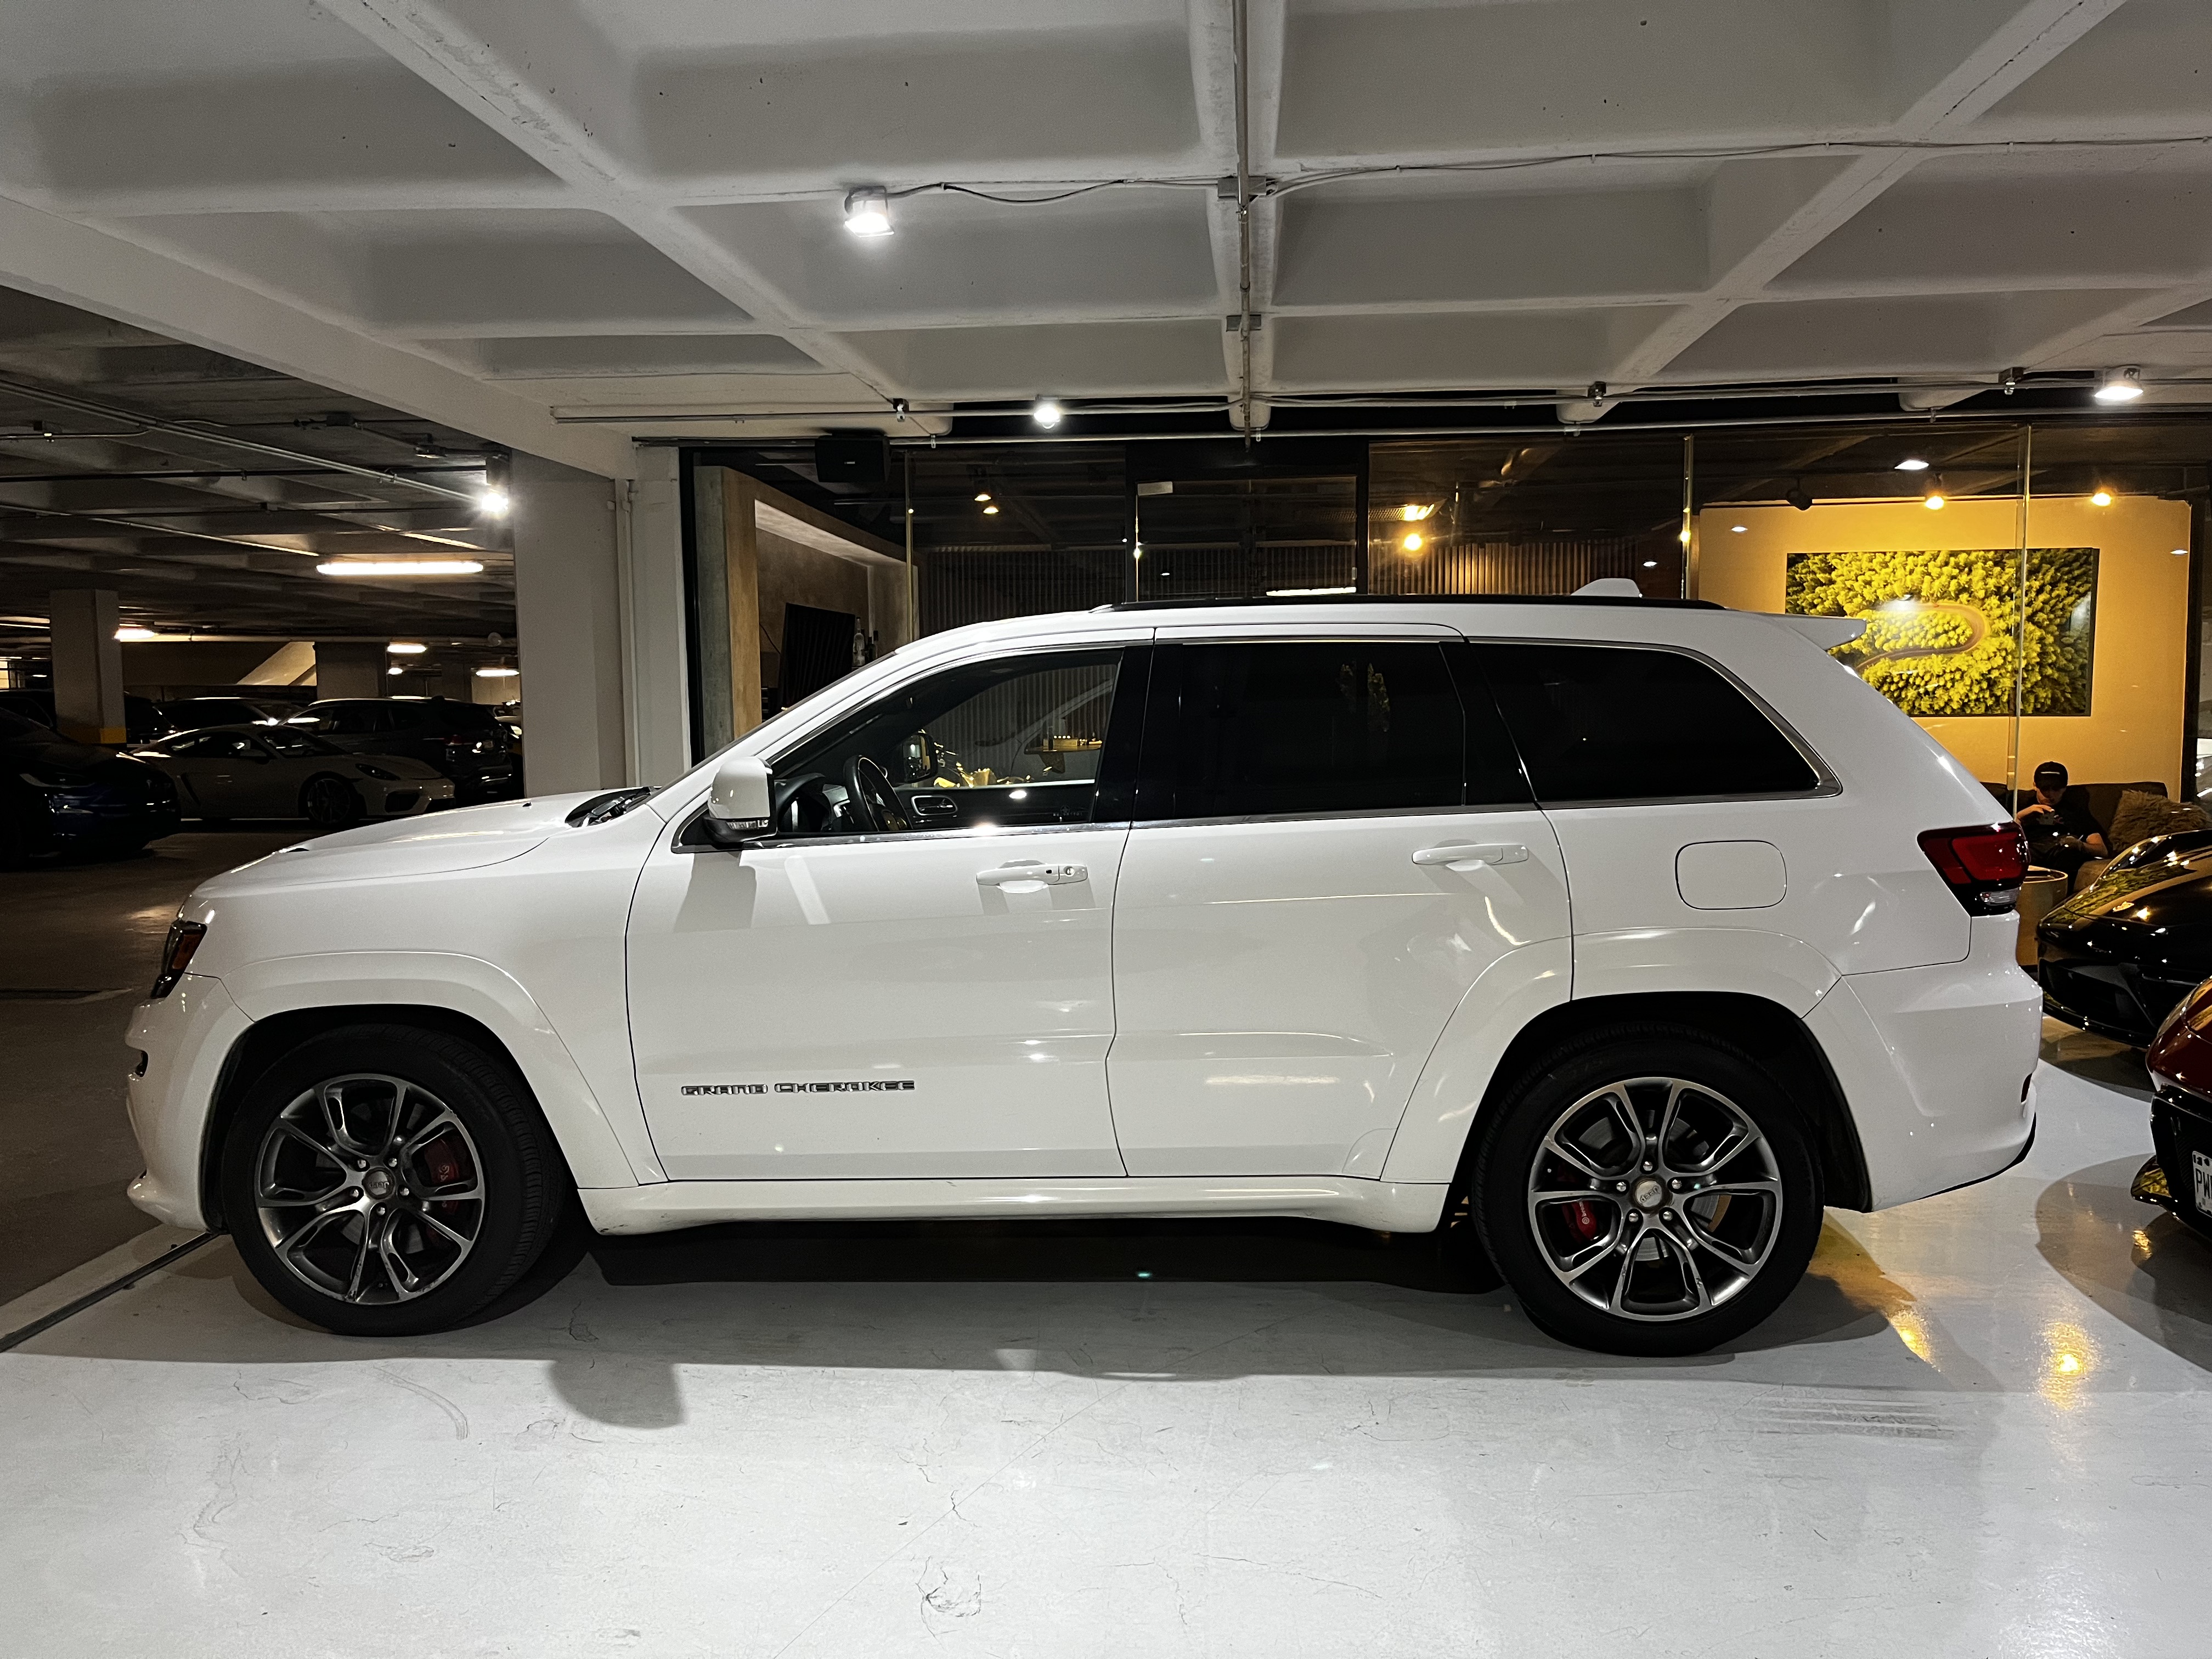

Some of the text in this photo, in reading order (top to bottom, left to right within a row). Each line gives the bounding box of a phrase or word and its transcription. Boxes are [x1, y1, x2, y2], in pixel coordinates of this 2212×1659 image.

[681, 1080, 915, 1096] GRAND CHEROKEE
[1640, 1186, 1661, 1203] Jeep
